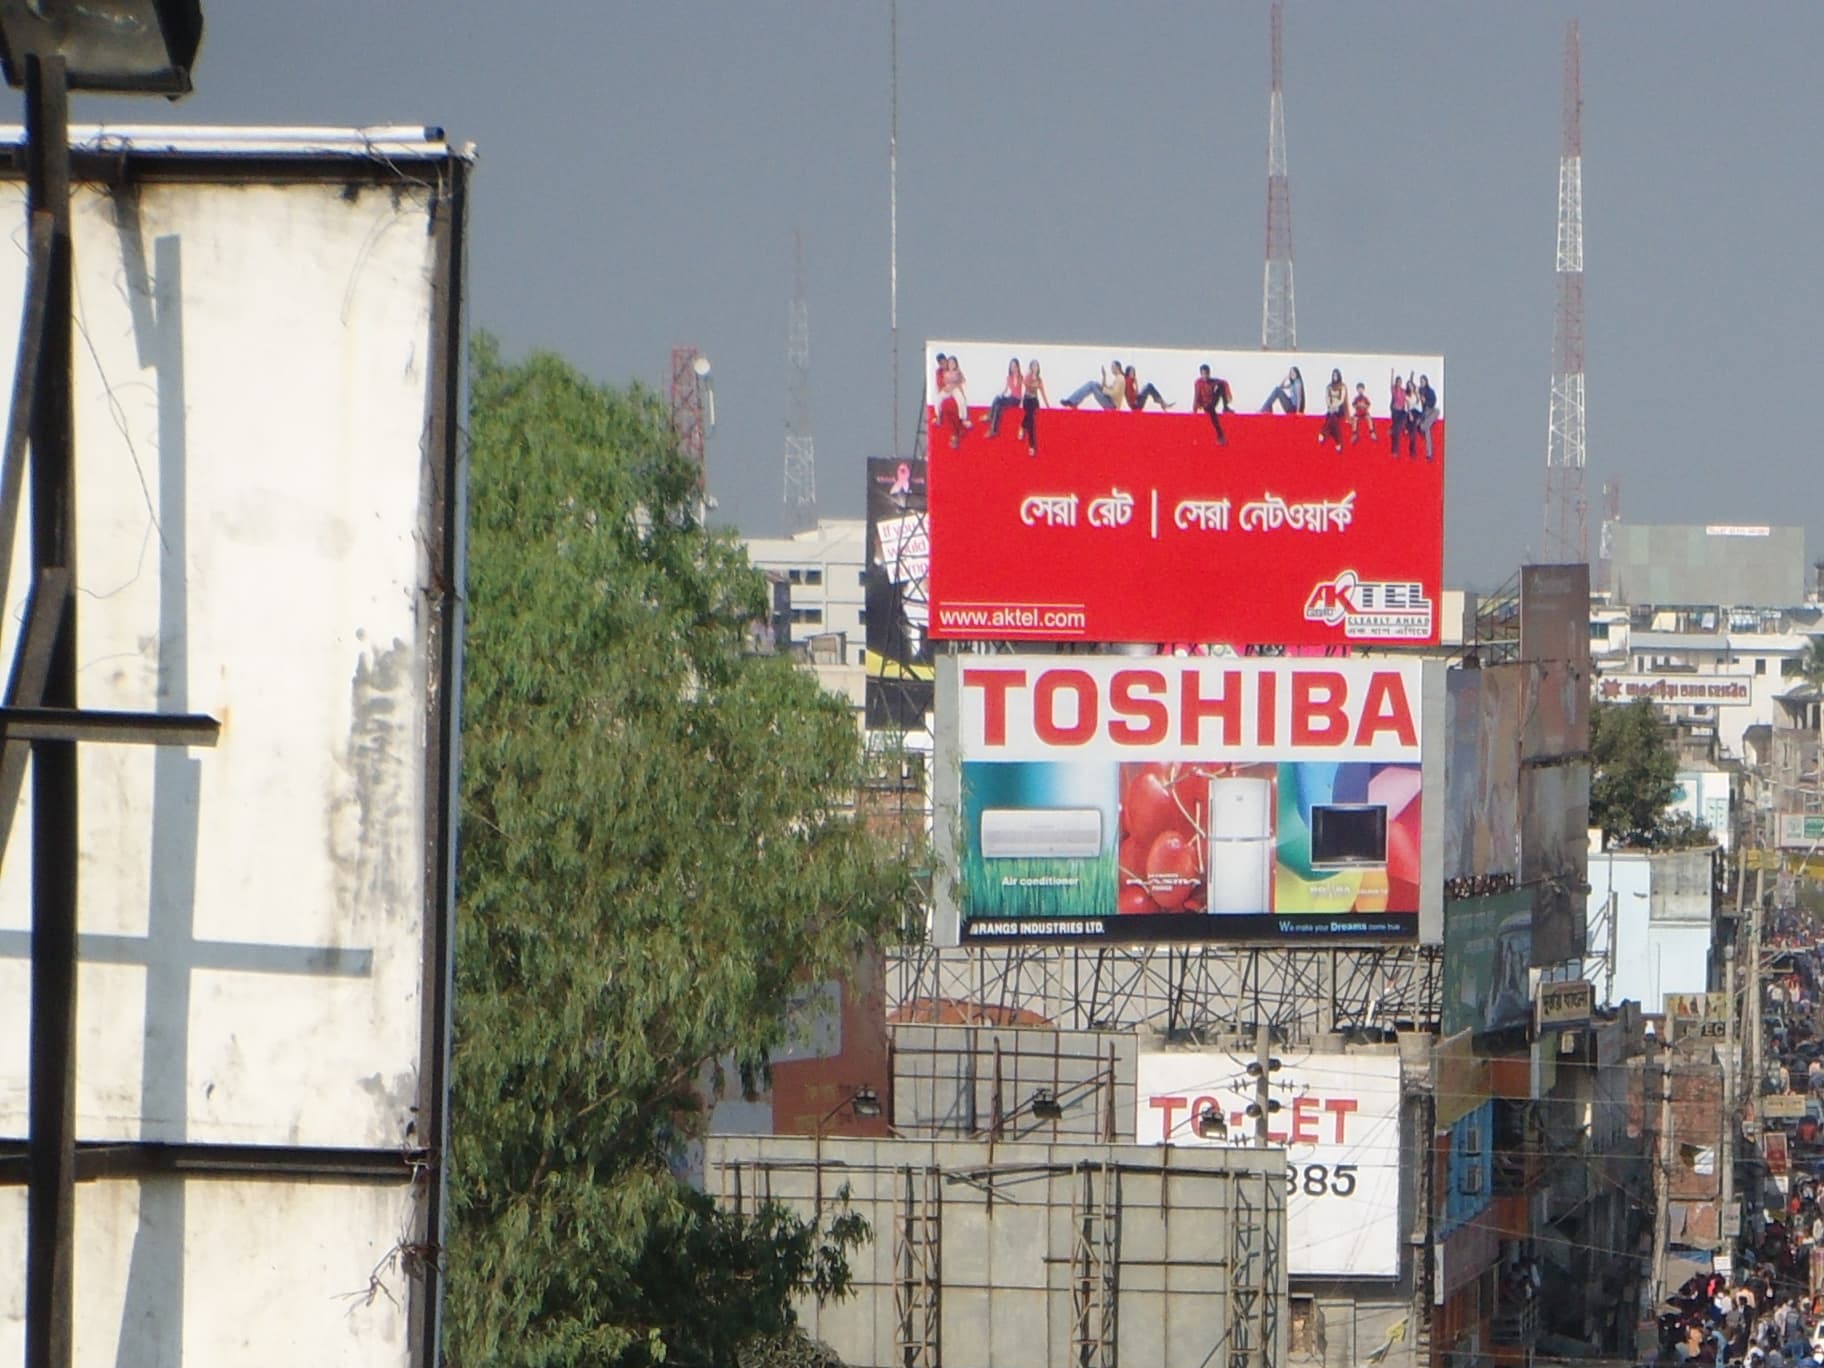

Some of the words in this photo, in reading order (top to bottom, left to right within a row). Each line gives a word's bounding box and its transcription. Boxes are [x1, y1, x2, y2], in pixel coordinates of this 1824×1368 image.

[1020, 493, 1079, 528] সেরা
[1087, 488, 1134, 528] রেট
[1174, 497, 1231, 531] সেরা
[1239, 490, 1357, 533] নেটওয়ার্ক
[1307, 584, 1430, 614] AKTEL
[939, 607, 1085, 627] www.aktel.com
[1347, 616, 1389, 625] CLEARLY
[1395, 616, 1430, 625] AHEAD
[963, 669, 1418, 748] TOSHIBA
[1001, 876, 1018, 886] Air
[1019, 876, 1079, 887] conditioner
[978, 923, 1017, 935] RANGS
[1020, 922, 1084, 935] INDUSTRIES
[1085, 922, 1105, 934] LTD.
[1330, 921, 1367, 932] Dreams
